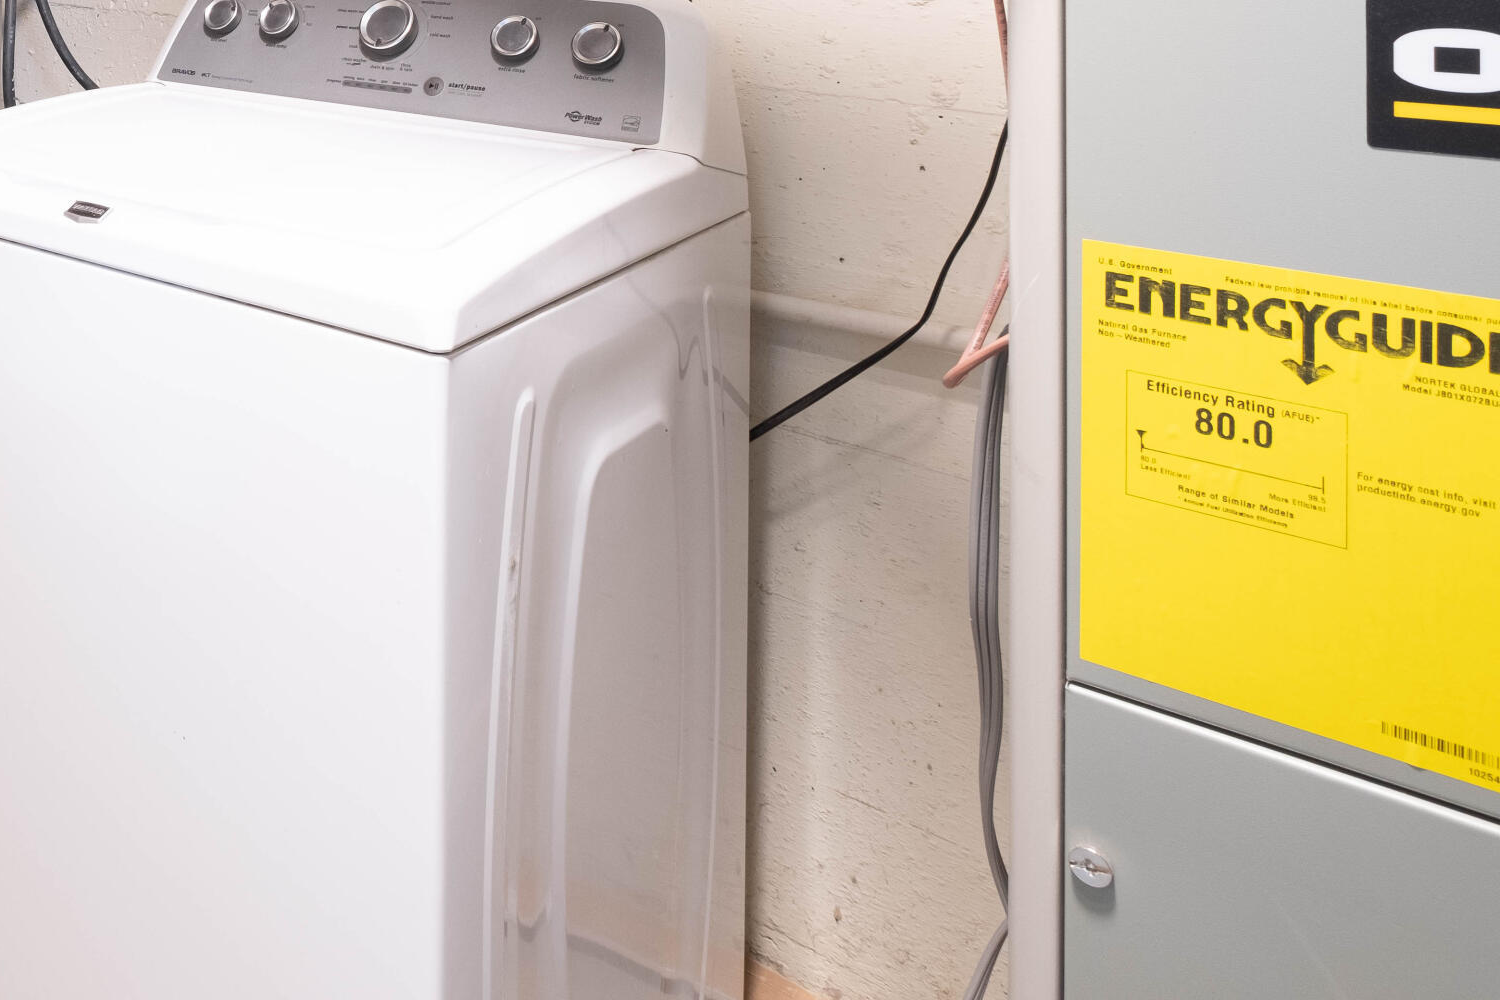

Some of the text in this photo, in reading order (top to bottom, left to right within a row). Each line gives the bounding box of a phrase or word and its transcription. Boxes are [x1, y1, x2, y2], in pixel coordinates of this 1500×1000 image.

[448, 83, 486, 91] start/pause
[1120, 261, 1172, 275] Government
[1225, 276, 1255, 287] Federal
[1275, 285, 1310, 297] prohibits
[1314, 290, 1347, 302] removal
[1350, 295, 1358, 303] of
[1361, 296, 1377, 306] this
[1436, 309, 1482, 322] consumer
[1098, 319, 1129, 331] Natural
[1132, 325, 1148, 334] Gas
[1402, 383, 1432, 395] Model
[1415, 375, 1500, 398] NORTEK GLOBAL
[1147, 379, 1218, 406] Efficiency
[1225, 395, 1275, 418] Rating
[1195, 408, 1273, 448] 80.0
[1140, 464, 1191, 480] Less Efficient
[1357, 471, 1373, 481] For
[1378, 477, 1413, 492] energy
[1418, 485, 1440, 498] cost
[1473, 497, 1496, 510] visit
[1178, 485, 1206, 499] Range
[1222, 495, 1256, 509] Similar
[1260, 504, 1295, 519] Models
[1269, 493, 1326, 513] More Efficient
